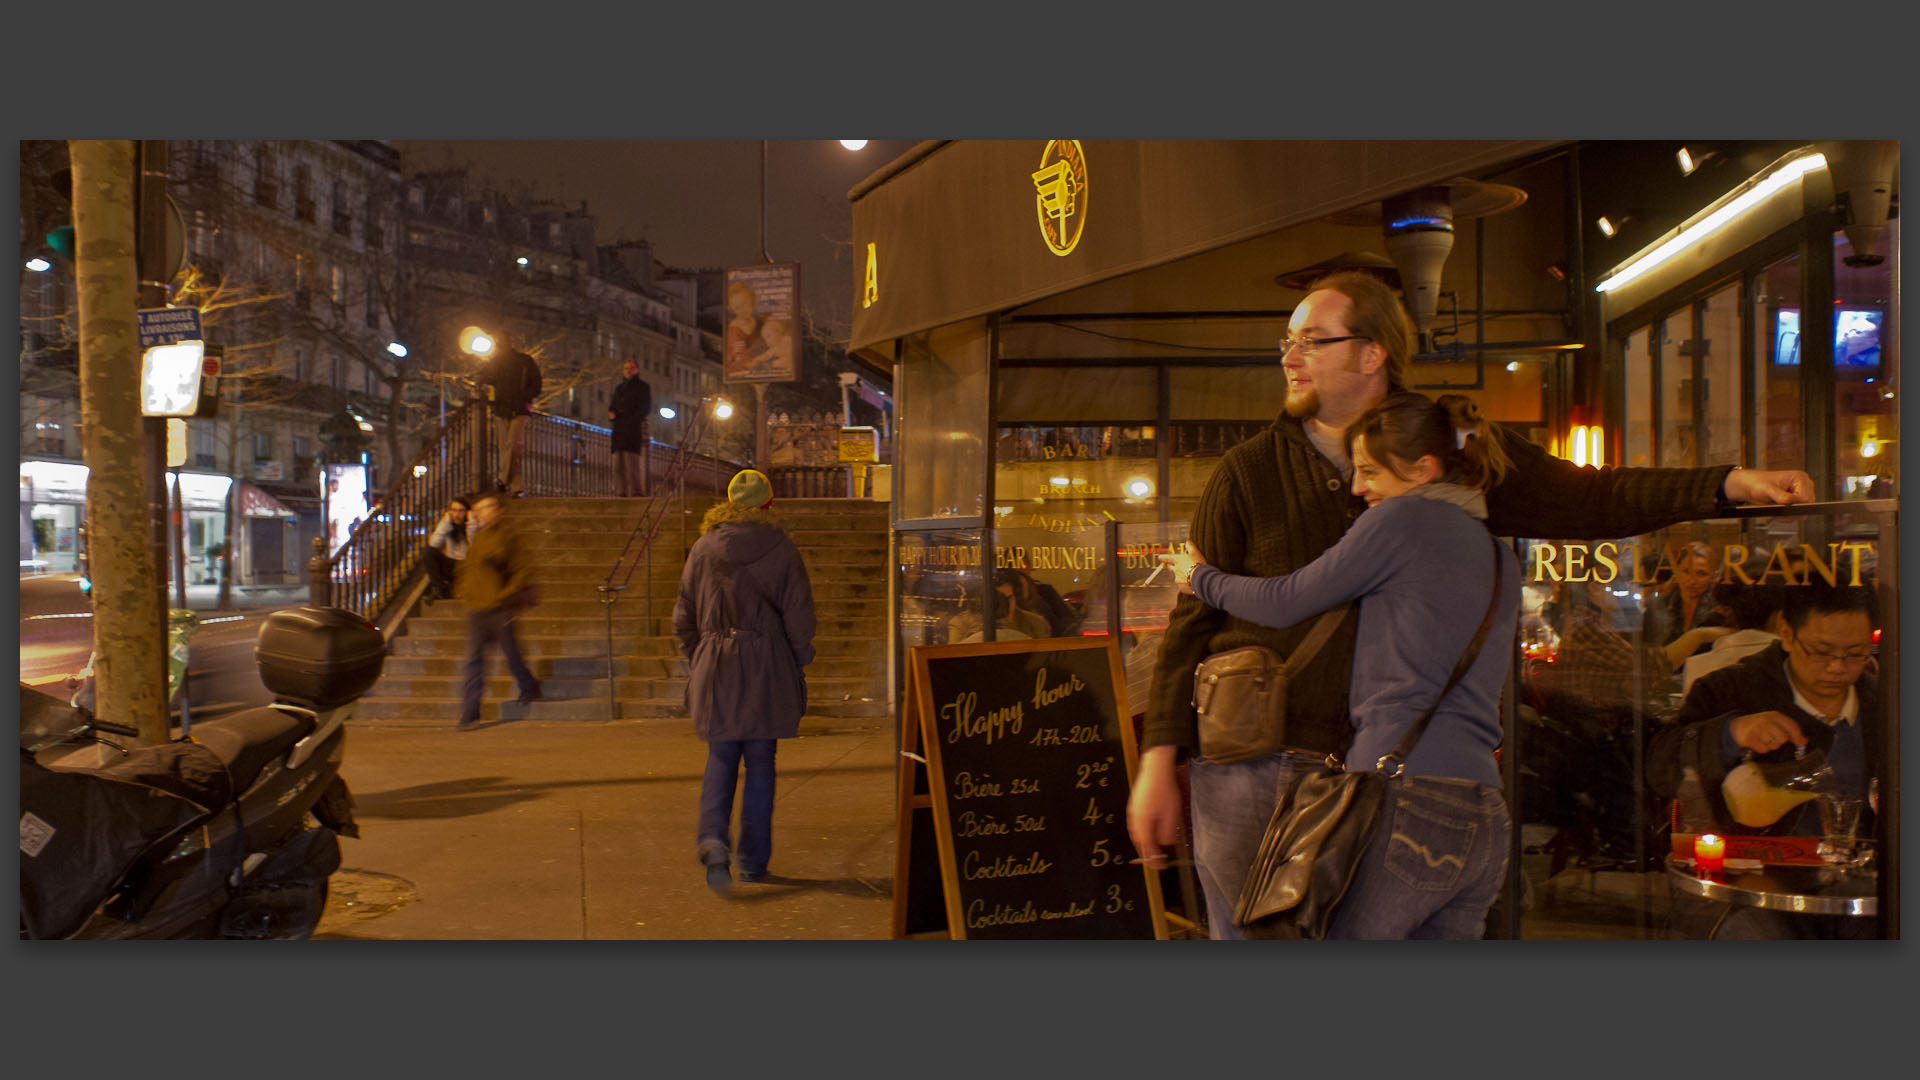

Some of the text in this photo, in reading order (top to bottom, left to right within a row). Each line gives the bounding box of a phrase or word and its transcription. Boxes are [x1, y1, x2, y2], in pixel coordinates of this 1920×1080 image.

[862, 241, 879, 309] A
[140, 321, 196, 336] LIVRAISONS
[1043, 443, 1089, 460] BAR
[1039, 484, 1101, 495] BRUNCH
[996, 546, 1027, 569] BAR
[1032, 546, 1097, 570] BRUNCH
[1531, 540, 1874, 587] RESTARANT
[941, 668, 1085, 745] Happy hour
[1029, 725, 1103, 746] 17h-20h
[954, 772, 1003, 799] Bière
[957, 811, 1009, 837] Bière
[964, 850, 1053, 881] Cocktails
[966, 899, 1038, 929] Cocktails
